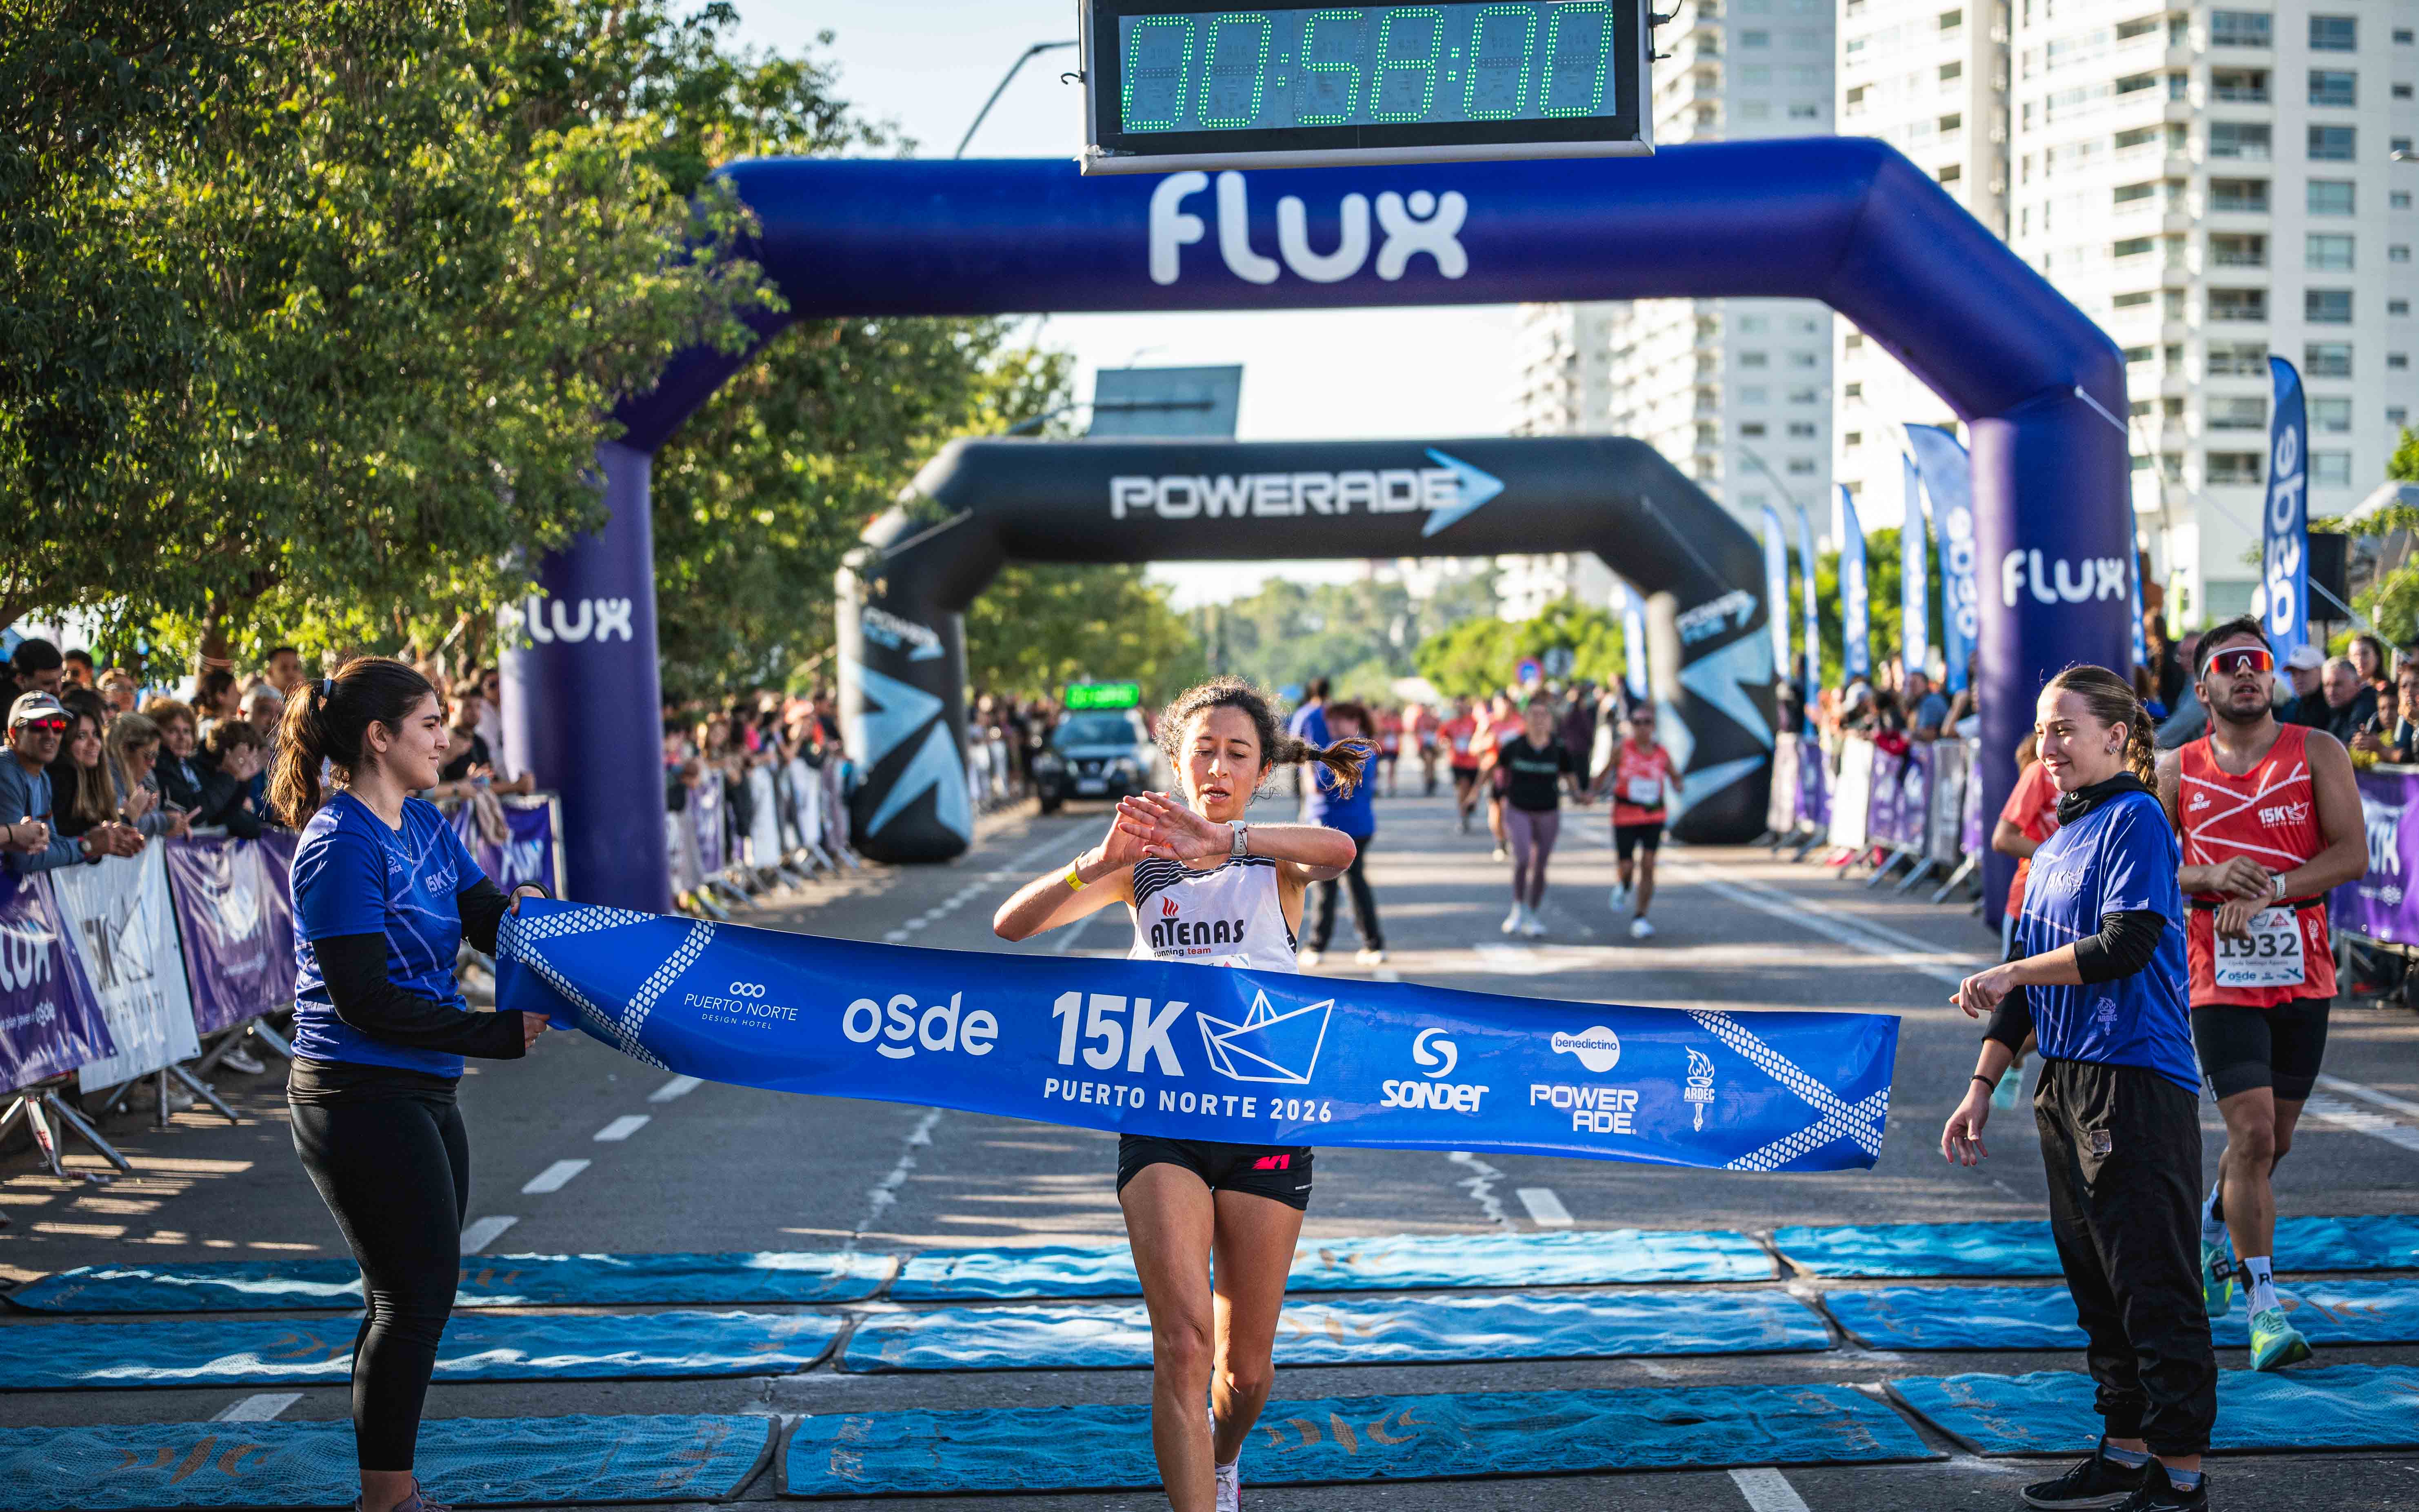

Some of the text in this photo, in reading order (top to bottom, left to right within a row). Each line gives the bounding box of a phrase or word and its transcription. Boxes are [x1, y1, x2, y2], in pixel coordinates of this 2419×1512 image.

[1121, 1, 1614, 130] 00:58:00
[1110, 468, 1461, 520] POWERADE
[2258, 805, 2286, 824] 15K
[1151, 918, 1244, 948] ATENAS
[2219, 933, 2299, 957] 1932
[1154, 946, 1211, 957] running team
[2228, 971, 2257, 982] osde
[684, 993, 798, 1021] PUERTO NORTE
[702, 1014, 772, 1029] DESIGN HOTEL
[842, 991, 998, 1059] osde
[1052, 991, 1189, 1077] 15K
[1555, 1037, 1617, 1050] benedictino
[1044, 1078, 1331, 1123] PUERTO NORTE 2026
[1530, 1084, 1639, 1112] POWER
[1684, 1087, 1715, 1101] ARDEC
